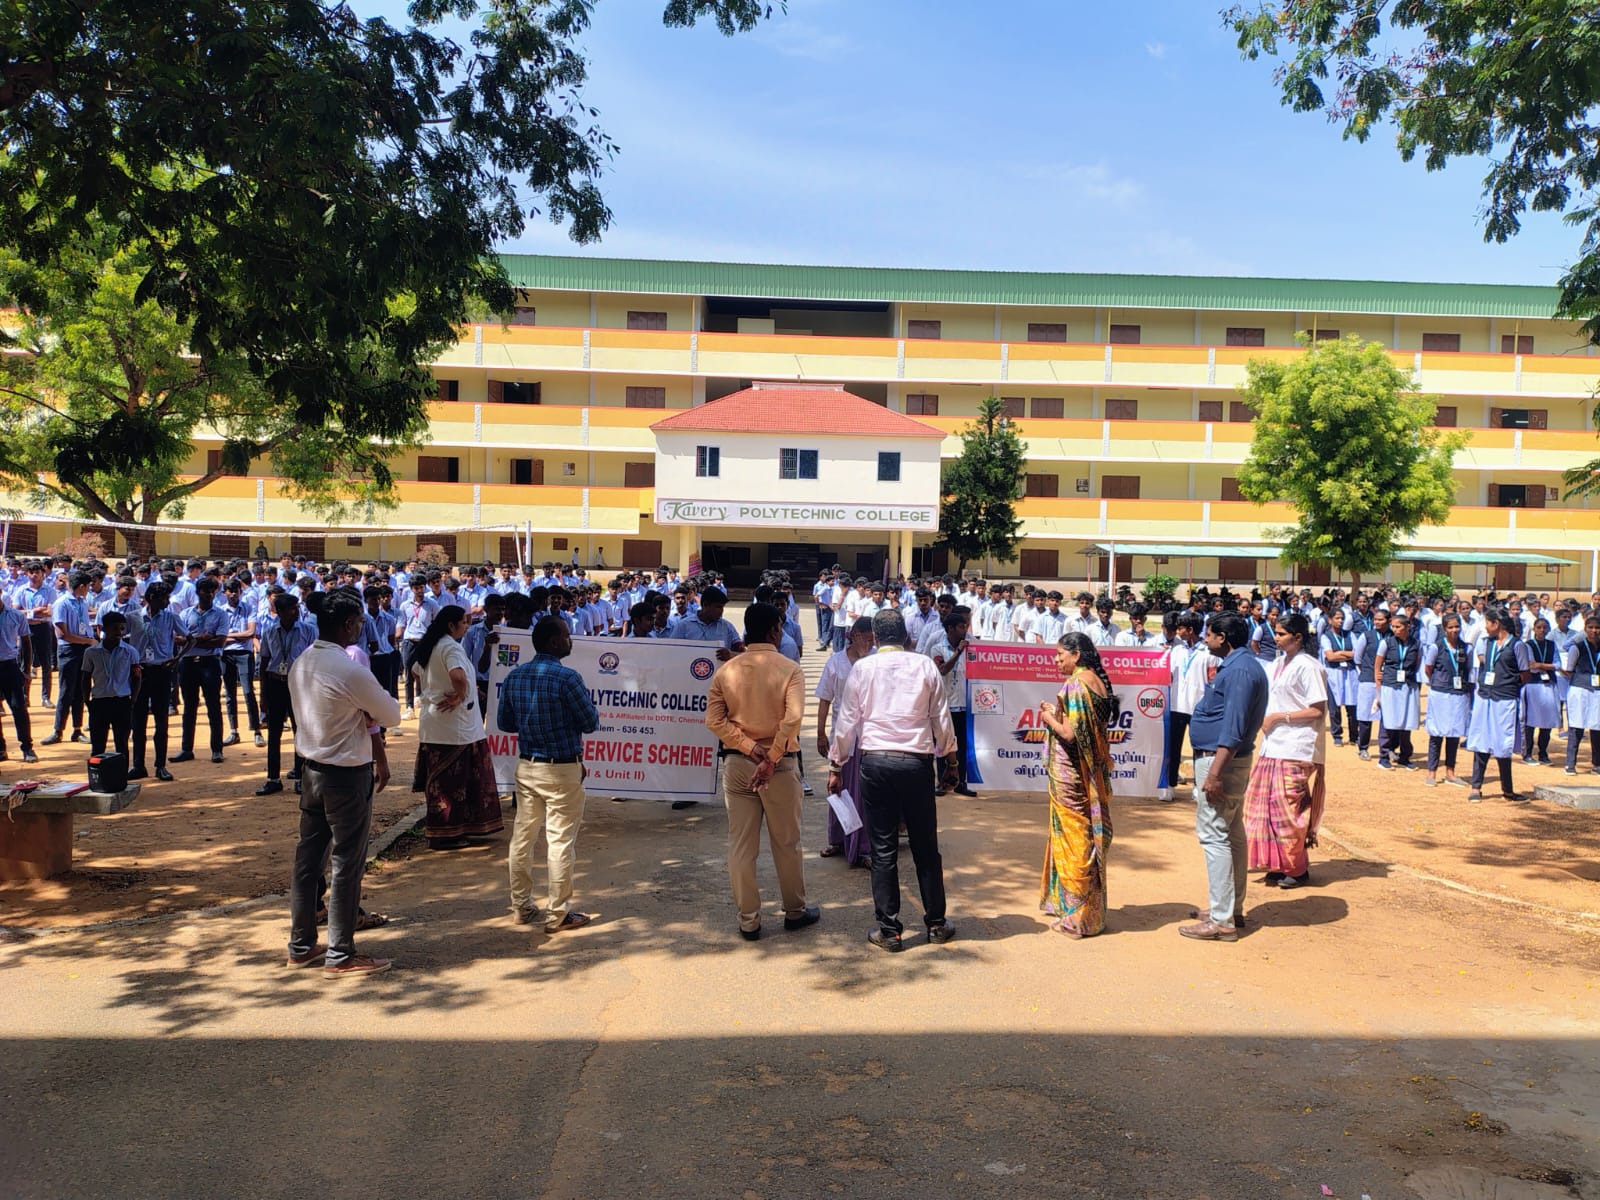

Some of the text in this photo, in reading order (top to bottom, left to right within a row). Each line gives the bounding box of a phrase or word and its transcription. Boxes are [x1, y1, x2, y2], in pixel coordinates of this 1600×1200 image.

[663, 501, 931, 522] Kavery POLYTECHNIC COLLEGE
[978, 652, 1024, 664] KAVERY
[1113, 657, 1167, 668] COLLEGE
[586, 689, 707, 712] LYTECHNIC COLLEG
[622, 725, 637, 733] 636
[581, 740, 713, 767] ERVICE SCHEME
[605, 769, 631, 780] Unit
